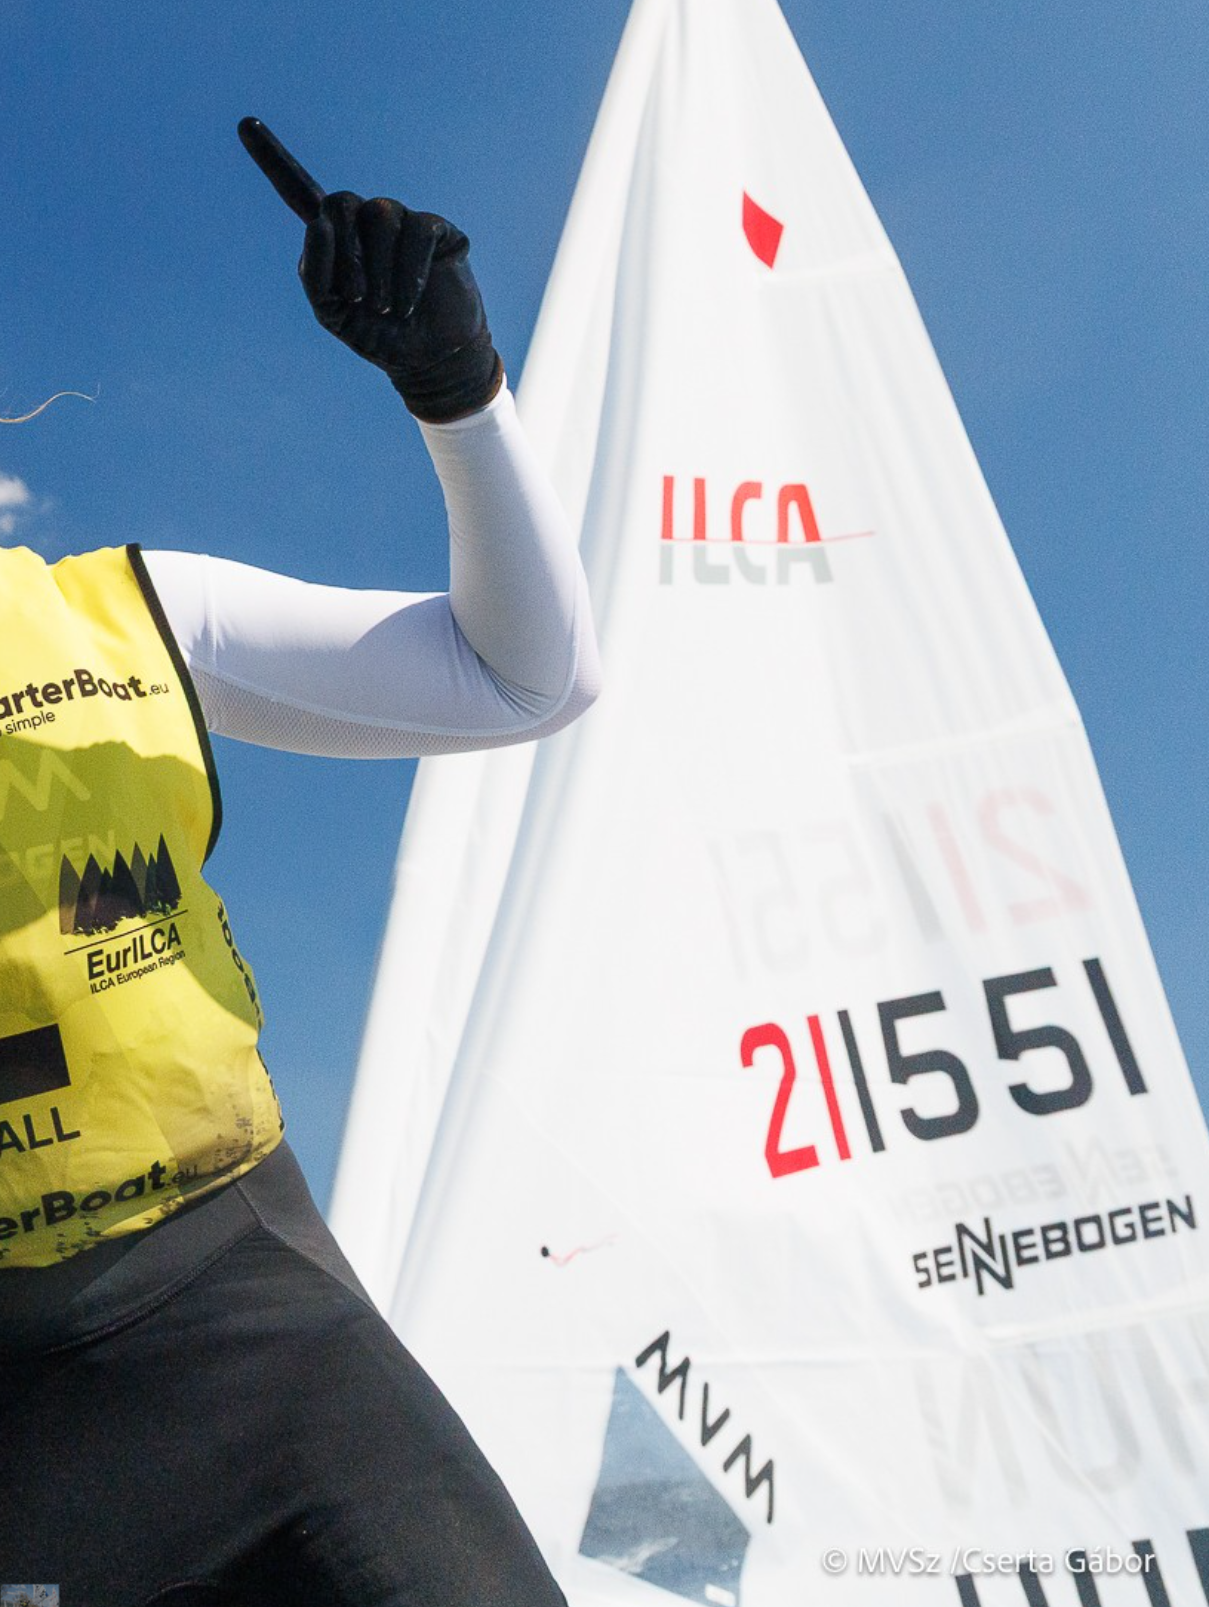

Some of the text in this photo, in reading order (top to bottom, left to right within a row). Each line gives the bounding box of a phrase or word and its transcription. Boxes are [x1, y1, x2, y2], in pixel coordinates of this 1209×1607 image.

[659, 475, 833, 585] ILCA
[5, 710, 56, 736] simple
[87, 923, 181, 981] EurILCA
[90, 950, 186, 994] ILCA European Region
[912, 1195, 1197, 1296] SENNEBOGEN
[636, 1331, 774, 1524] MVM
